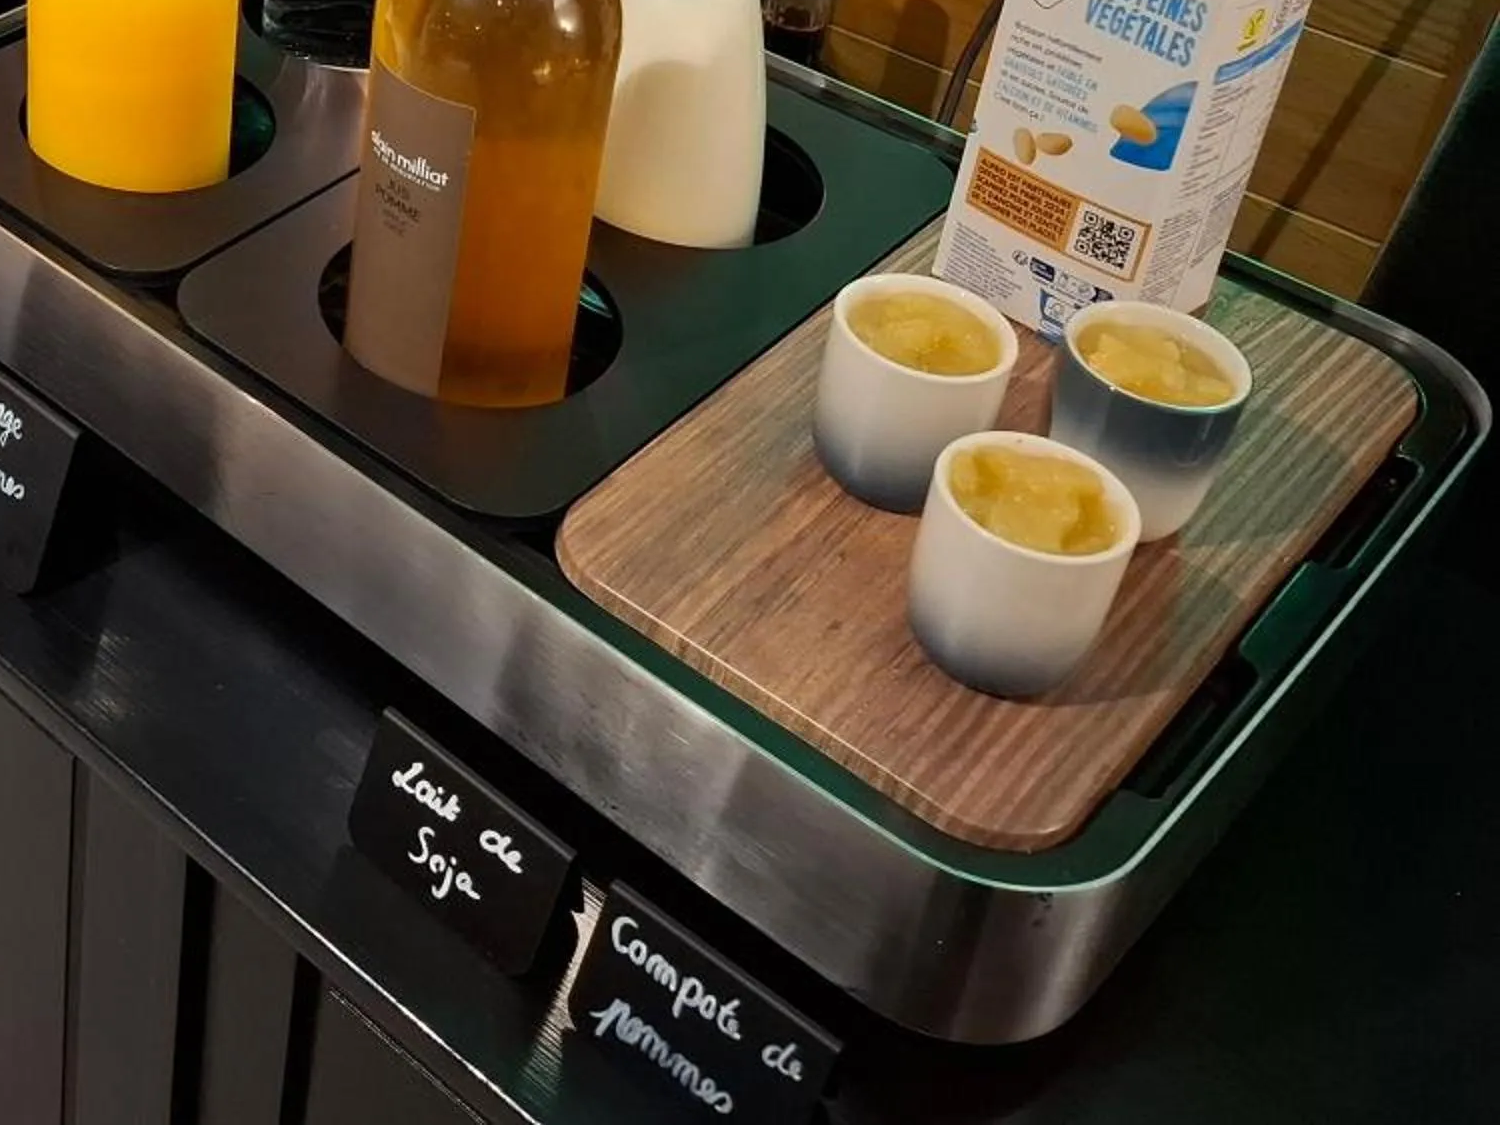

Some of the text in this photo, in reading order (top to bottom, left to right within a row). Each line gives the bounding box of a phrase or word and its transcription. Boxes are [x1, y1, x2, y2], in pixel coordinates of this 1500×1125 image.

[397, 153, 450, 187] milliat
[391, 761, 523, 875] Lait de
[407, 825, 482, 900] Soja
[588, 996, 736, 1115] pommes
[760, 1041, 803, 1082] de
